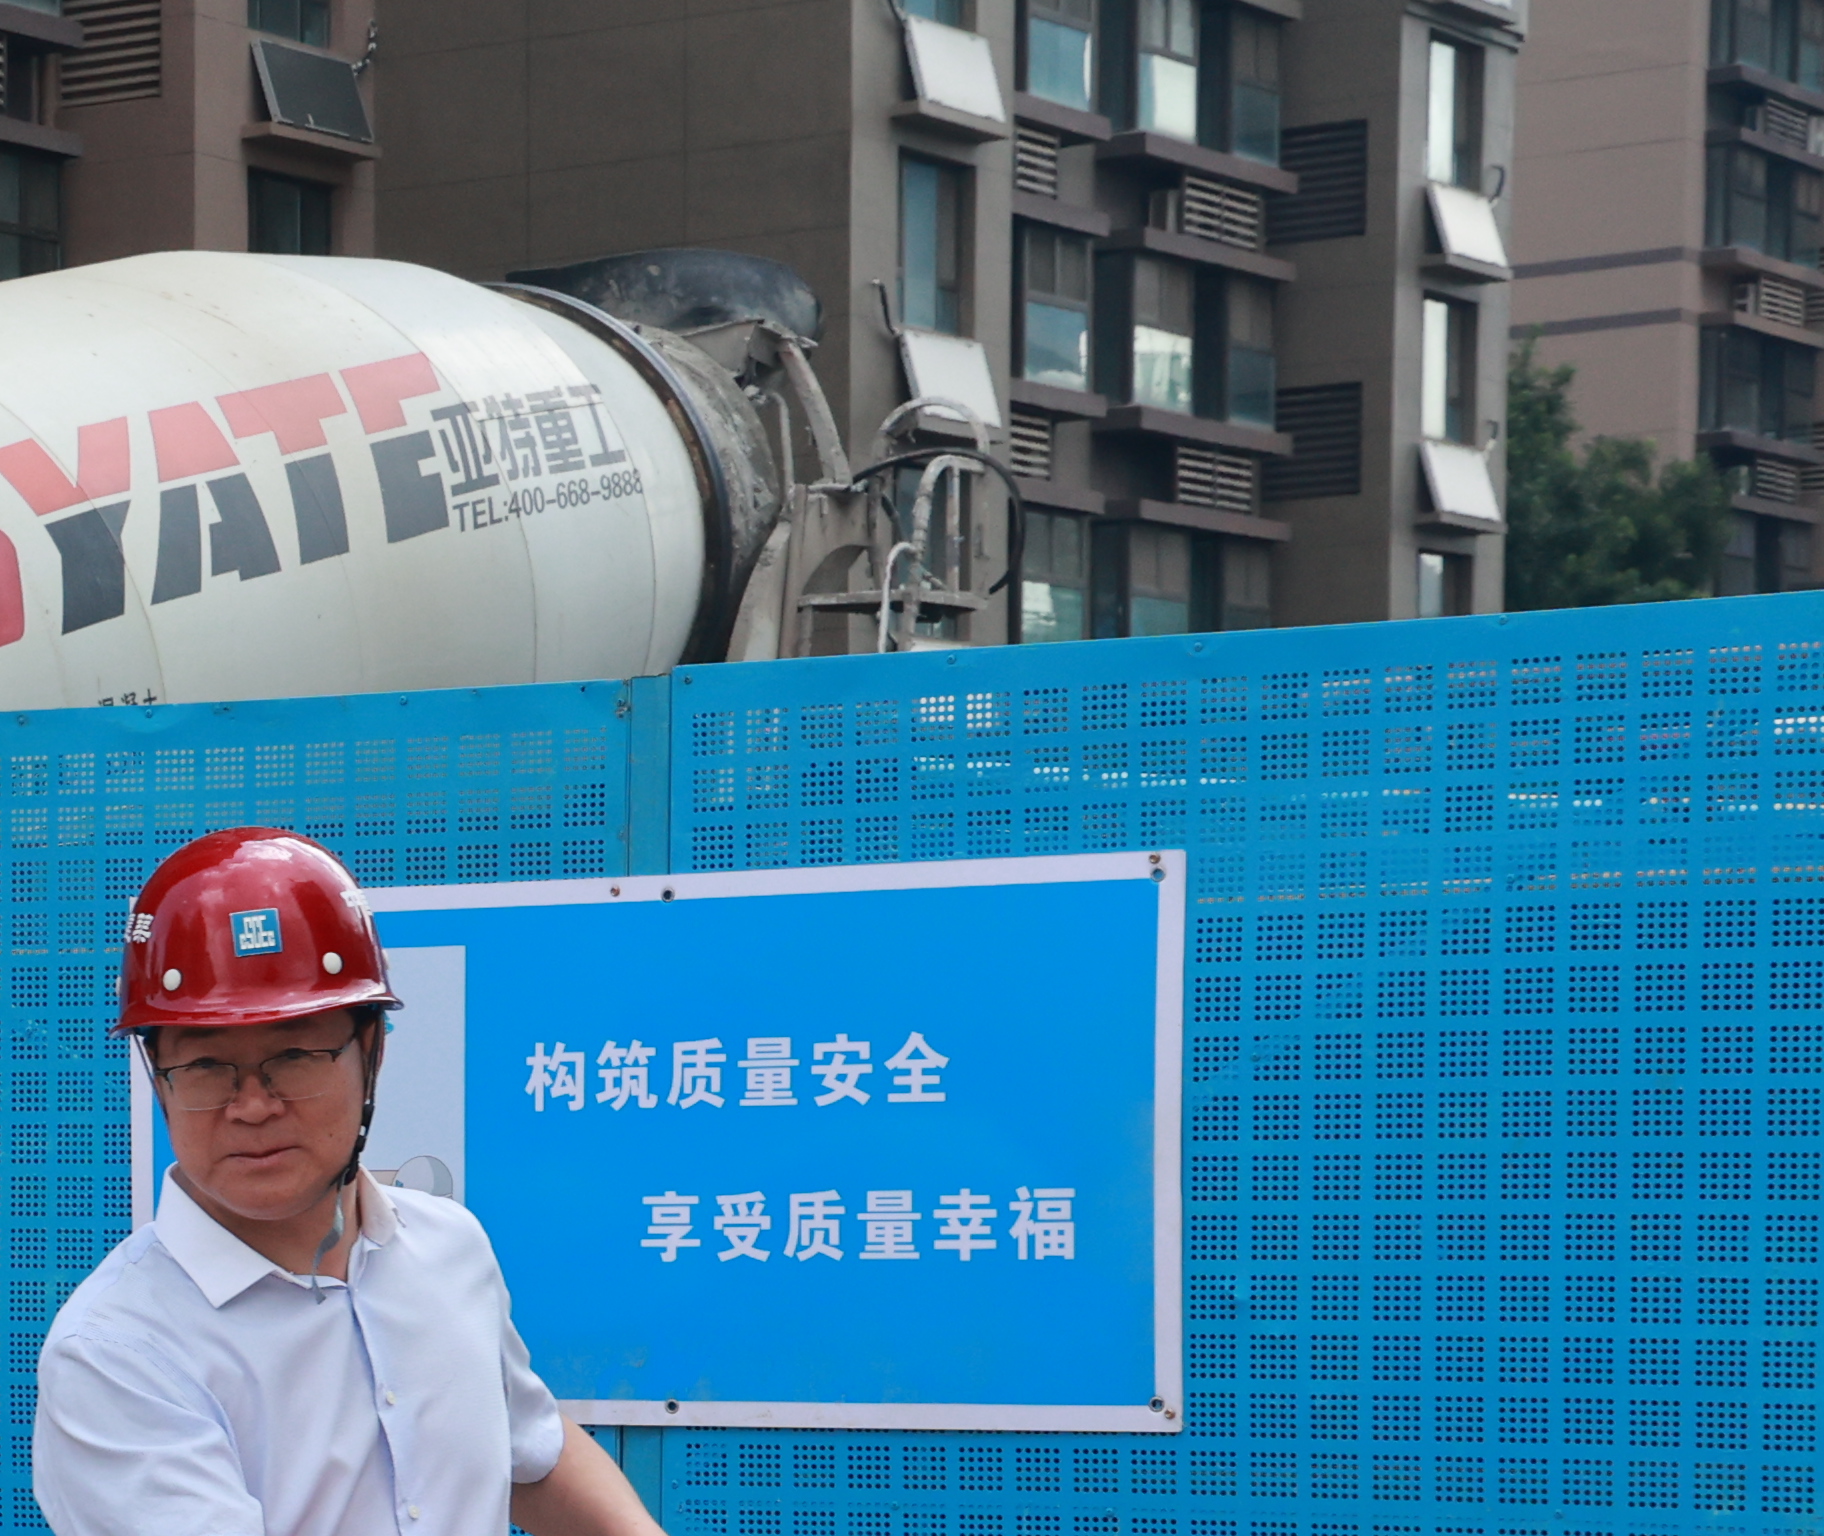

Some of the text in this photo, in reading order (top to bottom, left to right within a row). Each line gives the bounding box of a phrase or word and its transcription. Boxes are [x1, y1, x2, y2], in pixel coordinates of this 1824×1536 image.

[430, 384, 627, 497] 亚特重工
[524, 1032, 951, 1113] 构筑质量安全
[639, 1186, 1077, 1263] 享受质量幸福
